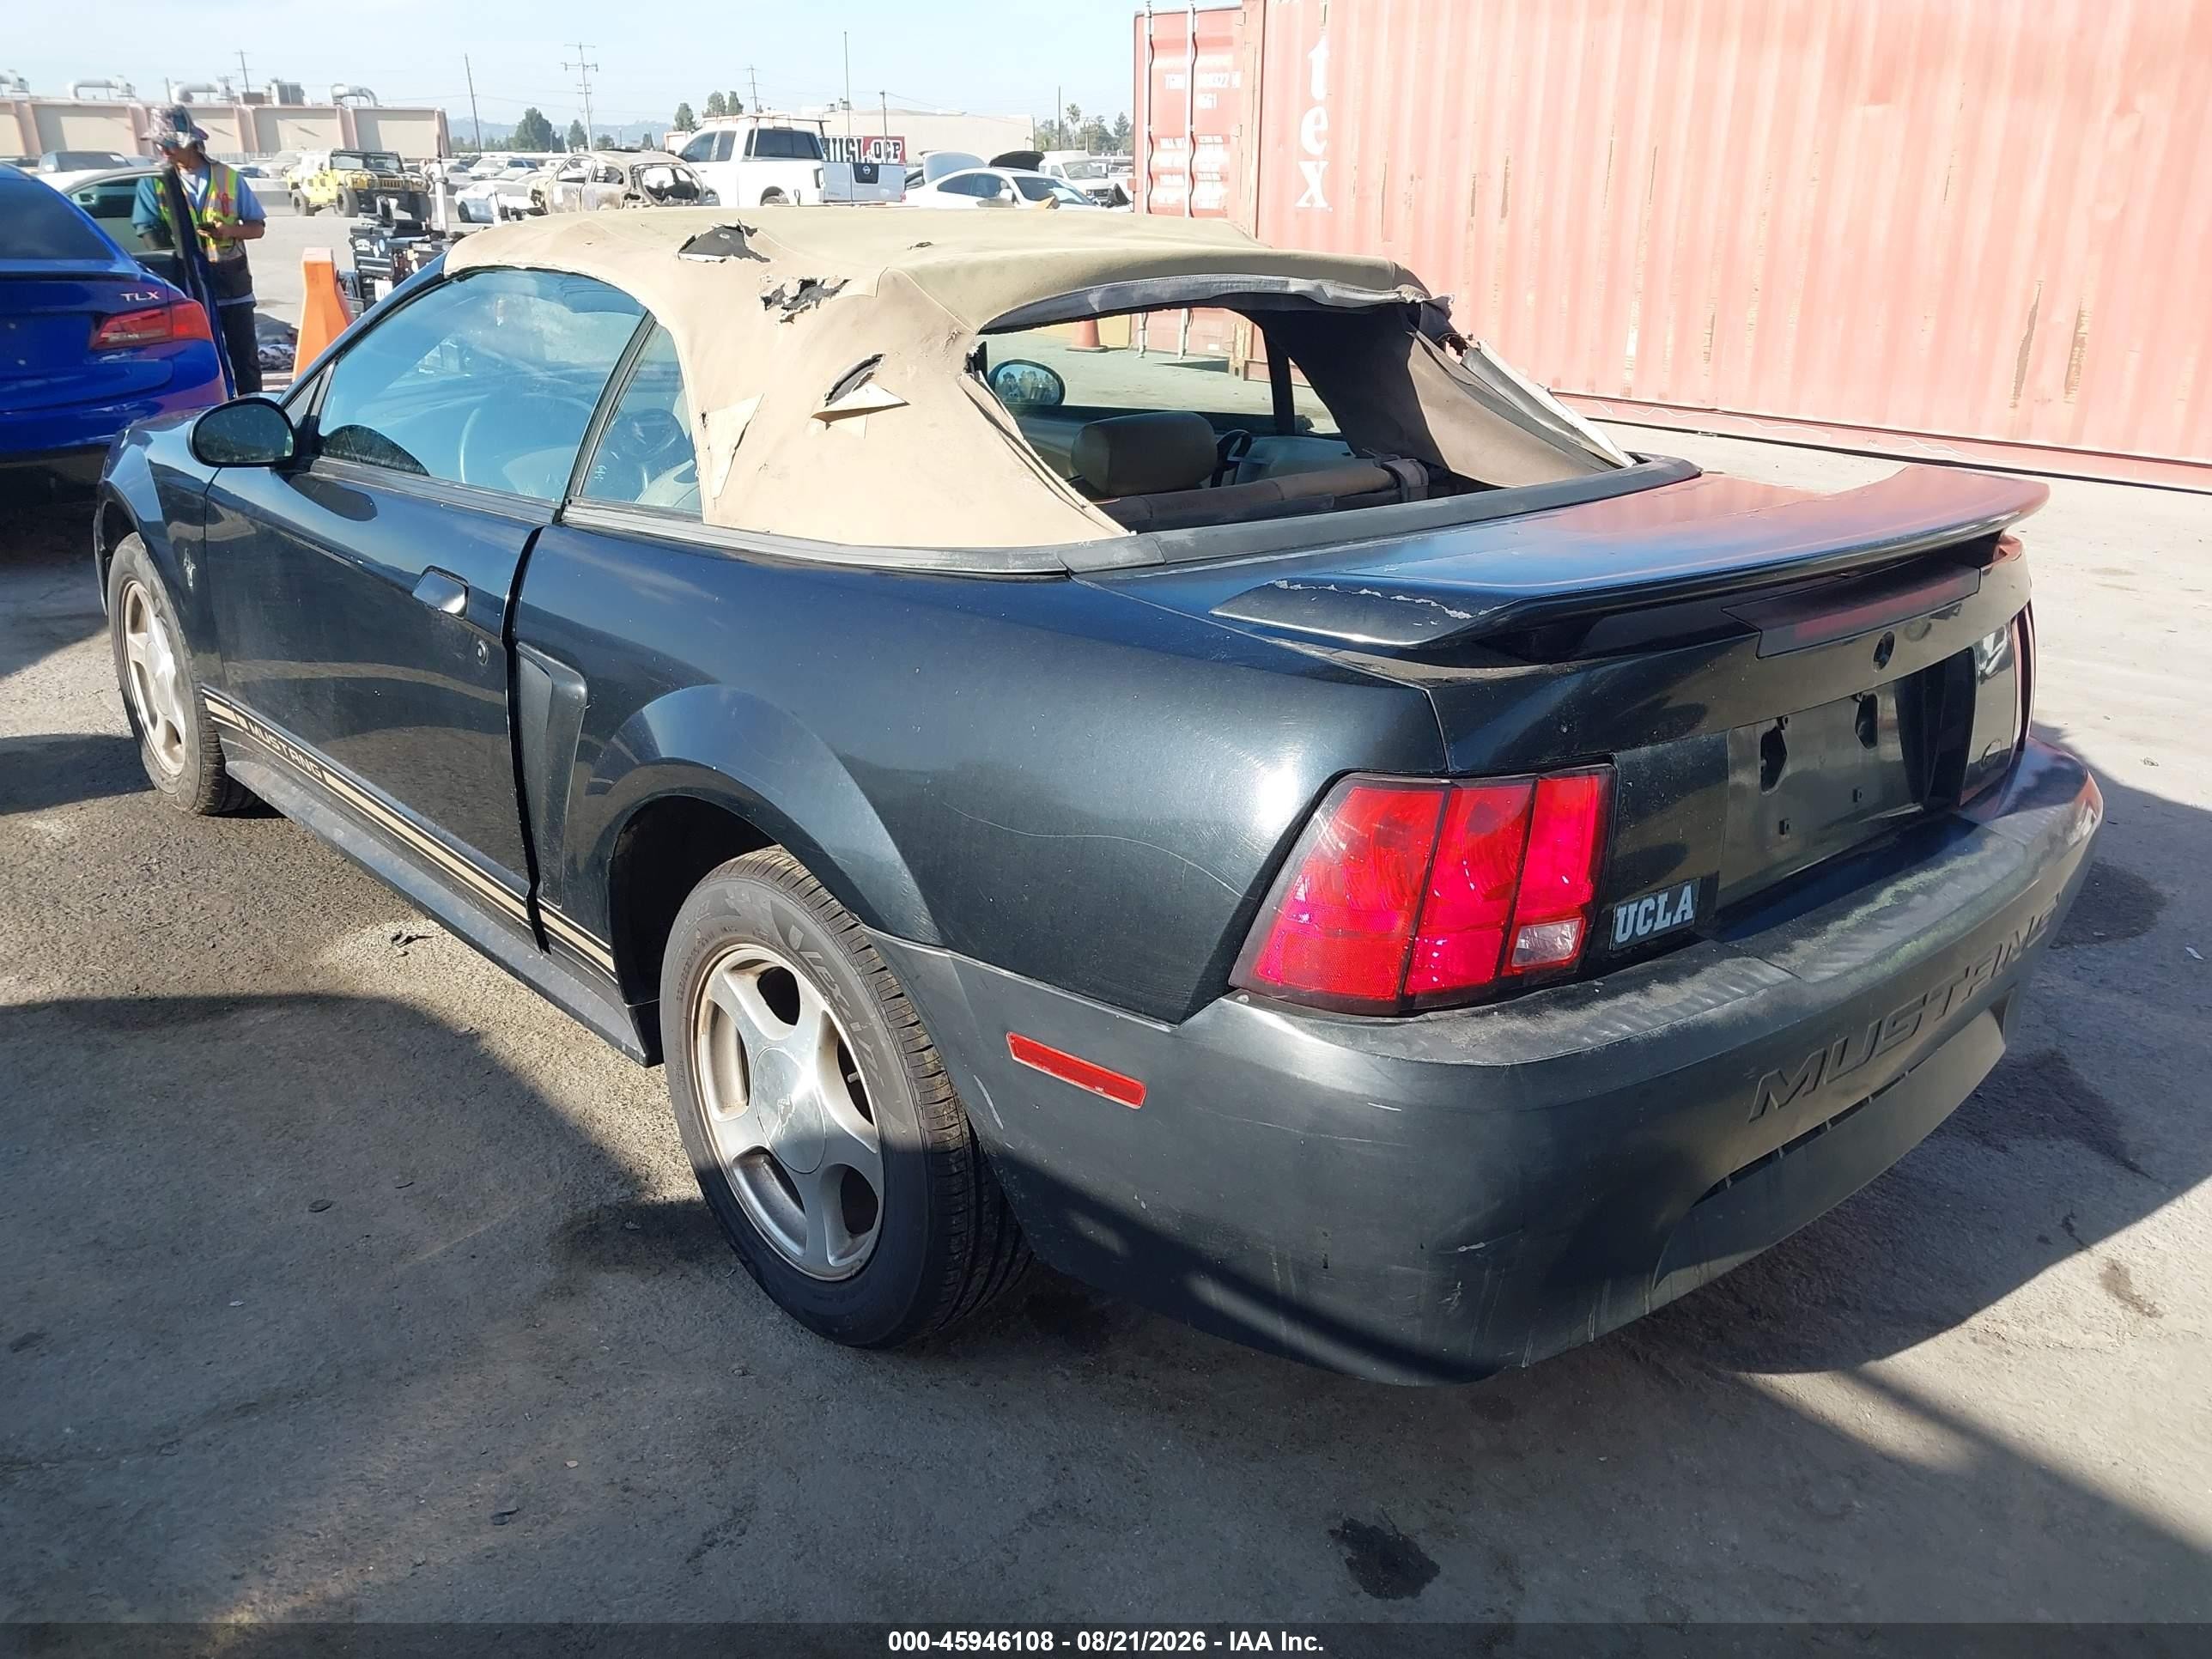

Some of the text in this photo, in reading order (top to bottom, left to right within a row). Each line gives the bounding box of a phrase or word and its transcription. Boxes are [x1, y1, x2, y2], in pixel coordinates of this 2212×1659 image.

[120, 291, 160, 302] TLX
[248, 722, 323, 779] MUSTANG
[1615, 884, 1693, 943] UCLA
